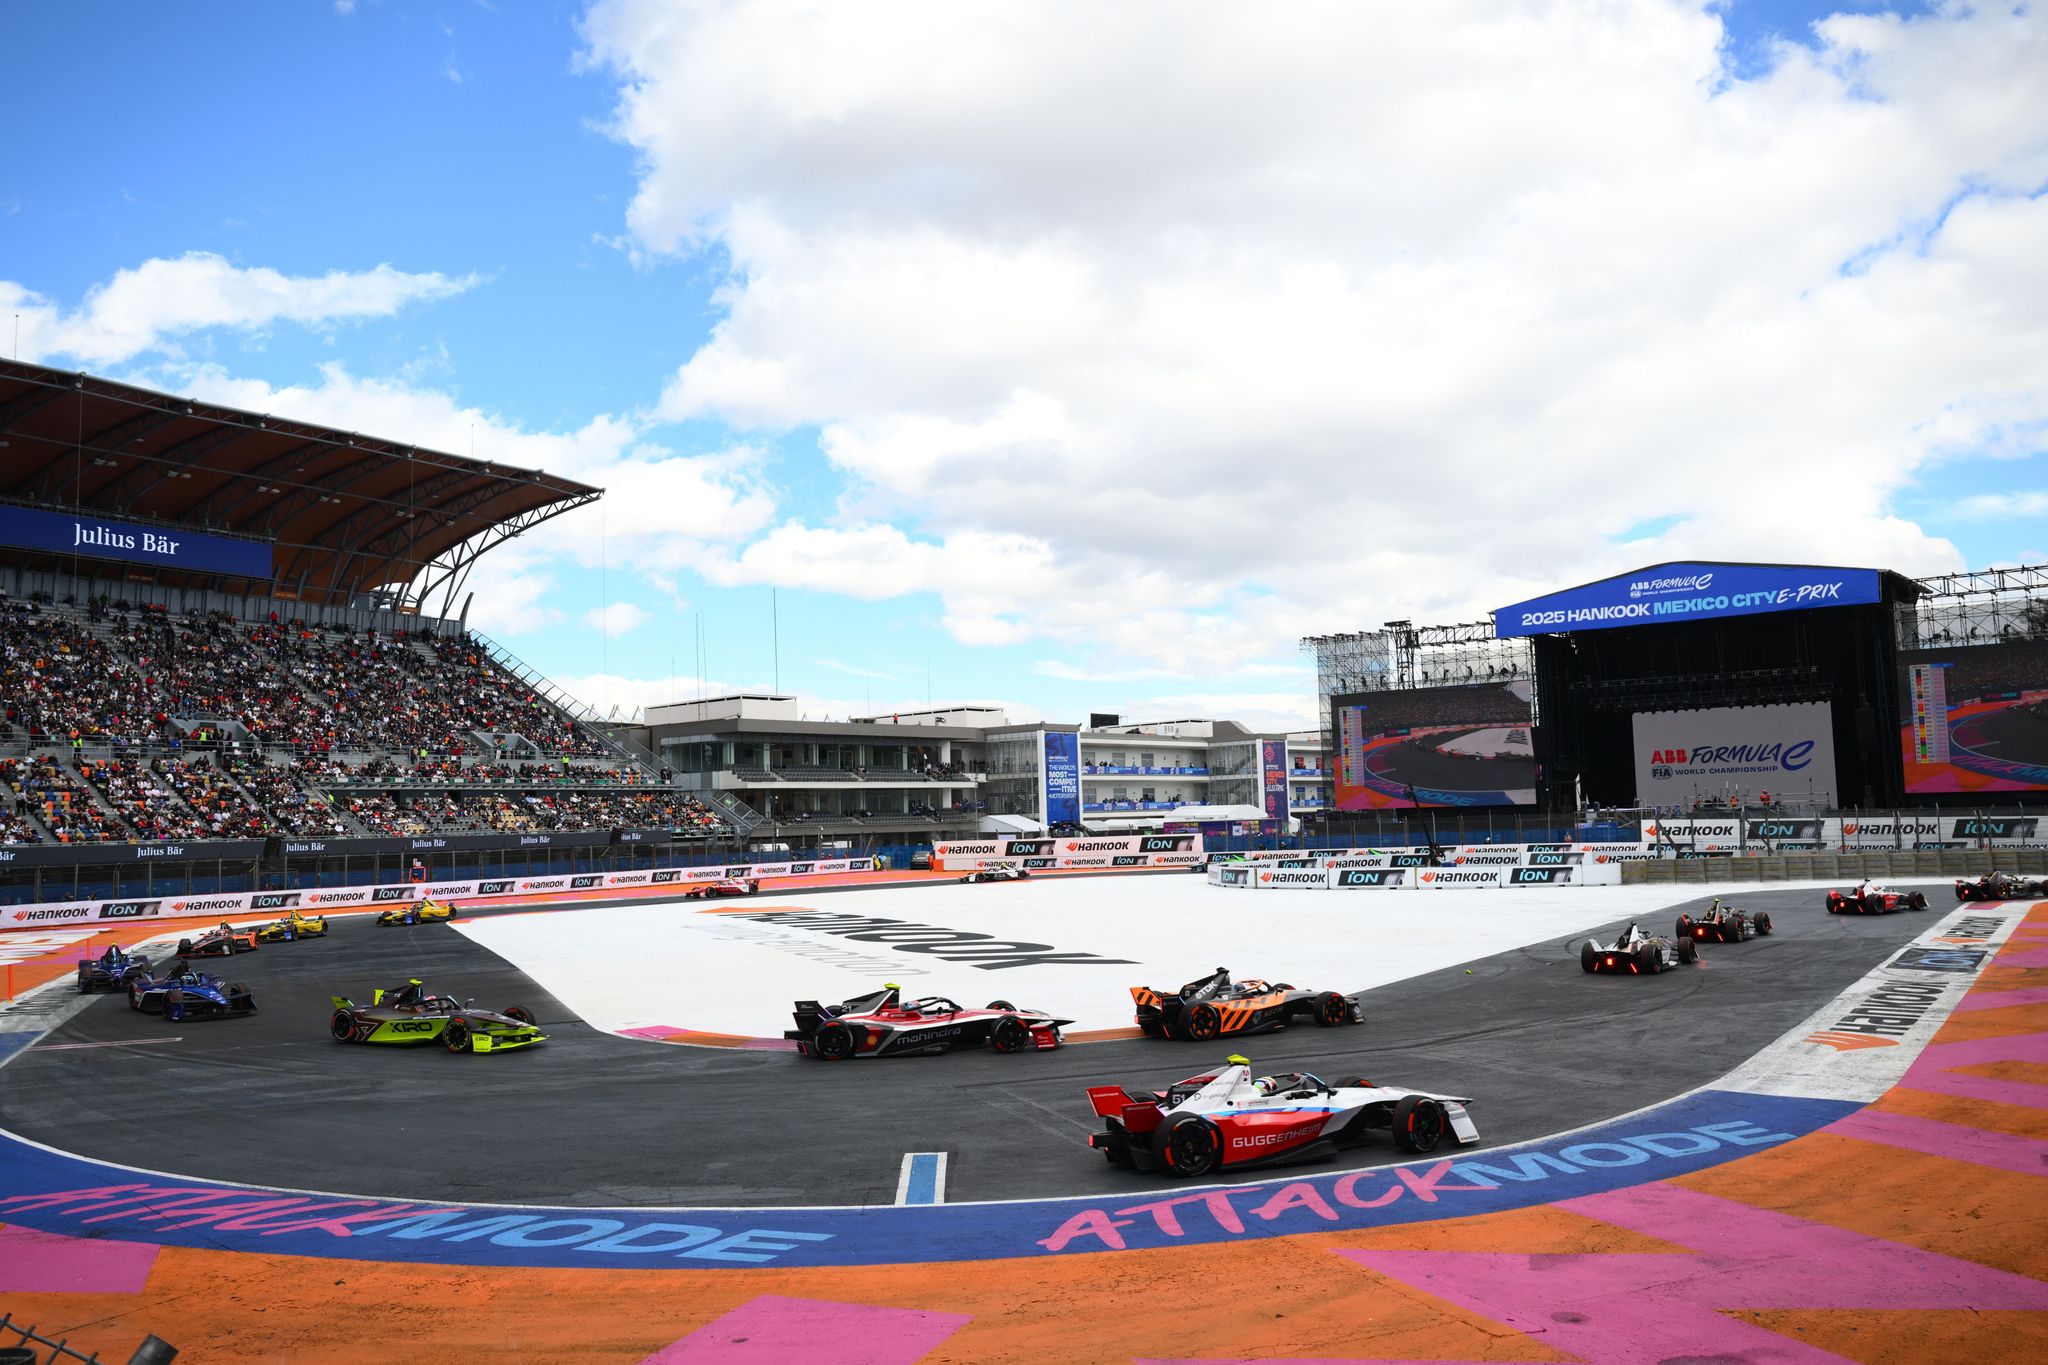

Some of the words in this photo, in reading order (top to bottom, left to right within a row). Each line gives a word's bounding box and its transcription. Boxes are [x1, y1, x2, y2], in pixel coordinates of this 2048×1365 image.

[74, 524, 135, 549] Julius
[142, 533, 180, 554] Bär
[1631, 582, 1650, 591] ABB
[1522, 611, 1565, 626] 2025
[1567, 602, 1650, 622] HANKOOK
[1654, 597, 1729, 615] MEXICO
[1732, 590, 1778, 608] CITY
[1777, 582, 1843, 605] E-PRIX
[1651, 749, 1687, 765] ABB
[1689, 743, 1783, 765] FORMULA
[1709, 765, 1778, 774] CHAMPIONSHIP
[286, 843, 308, 852] Julius
[311, 842, 326, 850] Bär
[412, 840, 432, 848] Julius
[433, 839, 446, 847] Bär
[137, 848, 164, 858] Julius
[167, 846, 184, 855] Bär
[841, 1005, 852, 1013] 21
[897, 1027, 961, 1045] mahindra
[1172, 1094, 1185, 1104] 51
[1233, 1123, 1321, 1148] GUGGENHEIM
[1036, 1160, 1498, 1251] ATTACK
[1447, 1119, 1797, 1187] MODE
[352, 1212, 837, 1262] MODE
